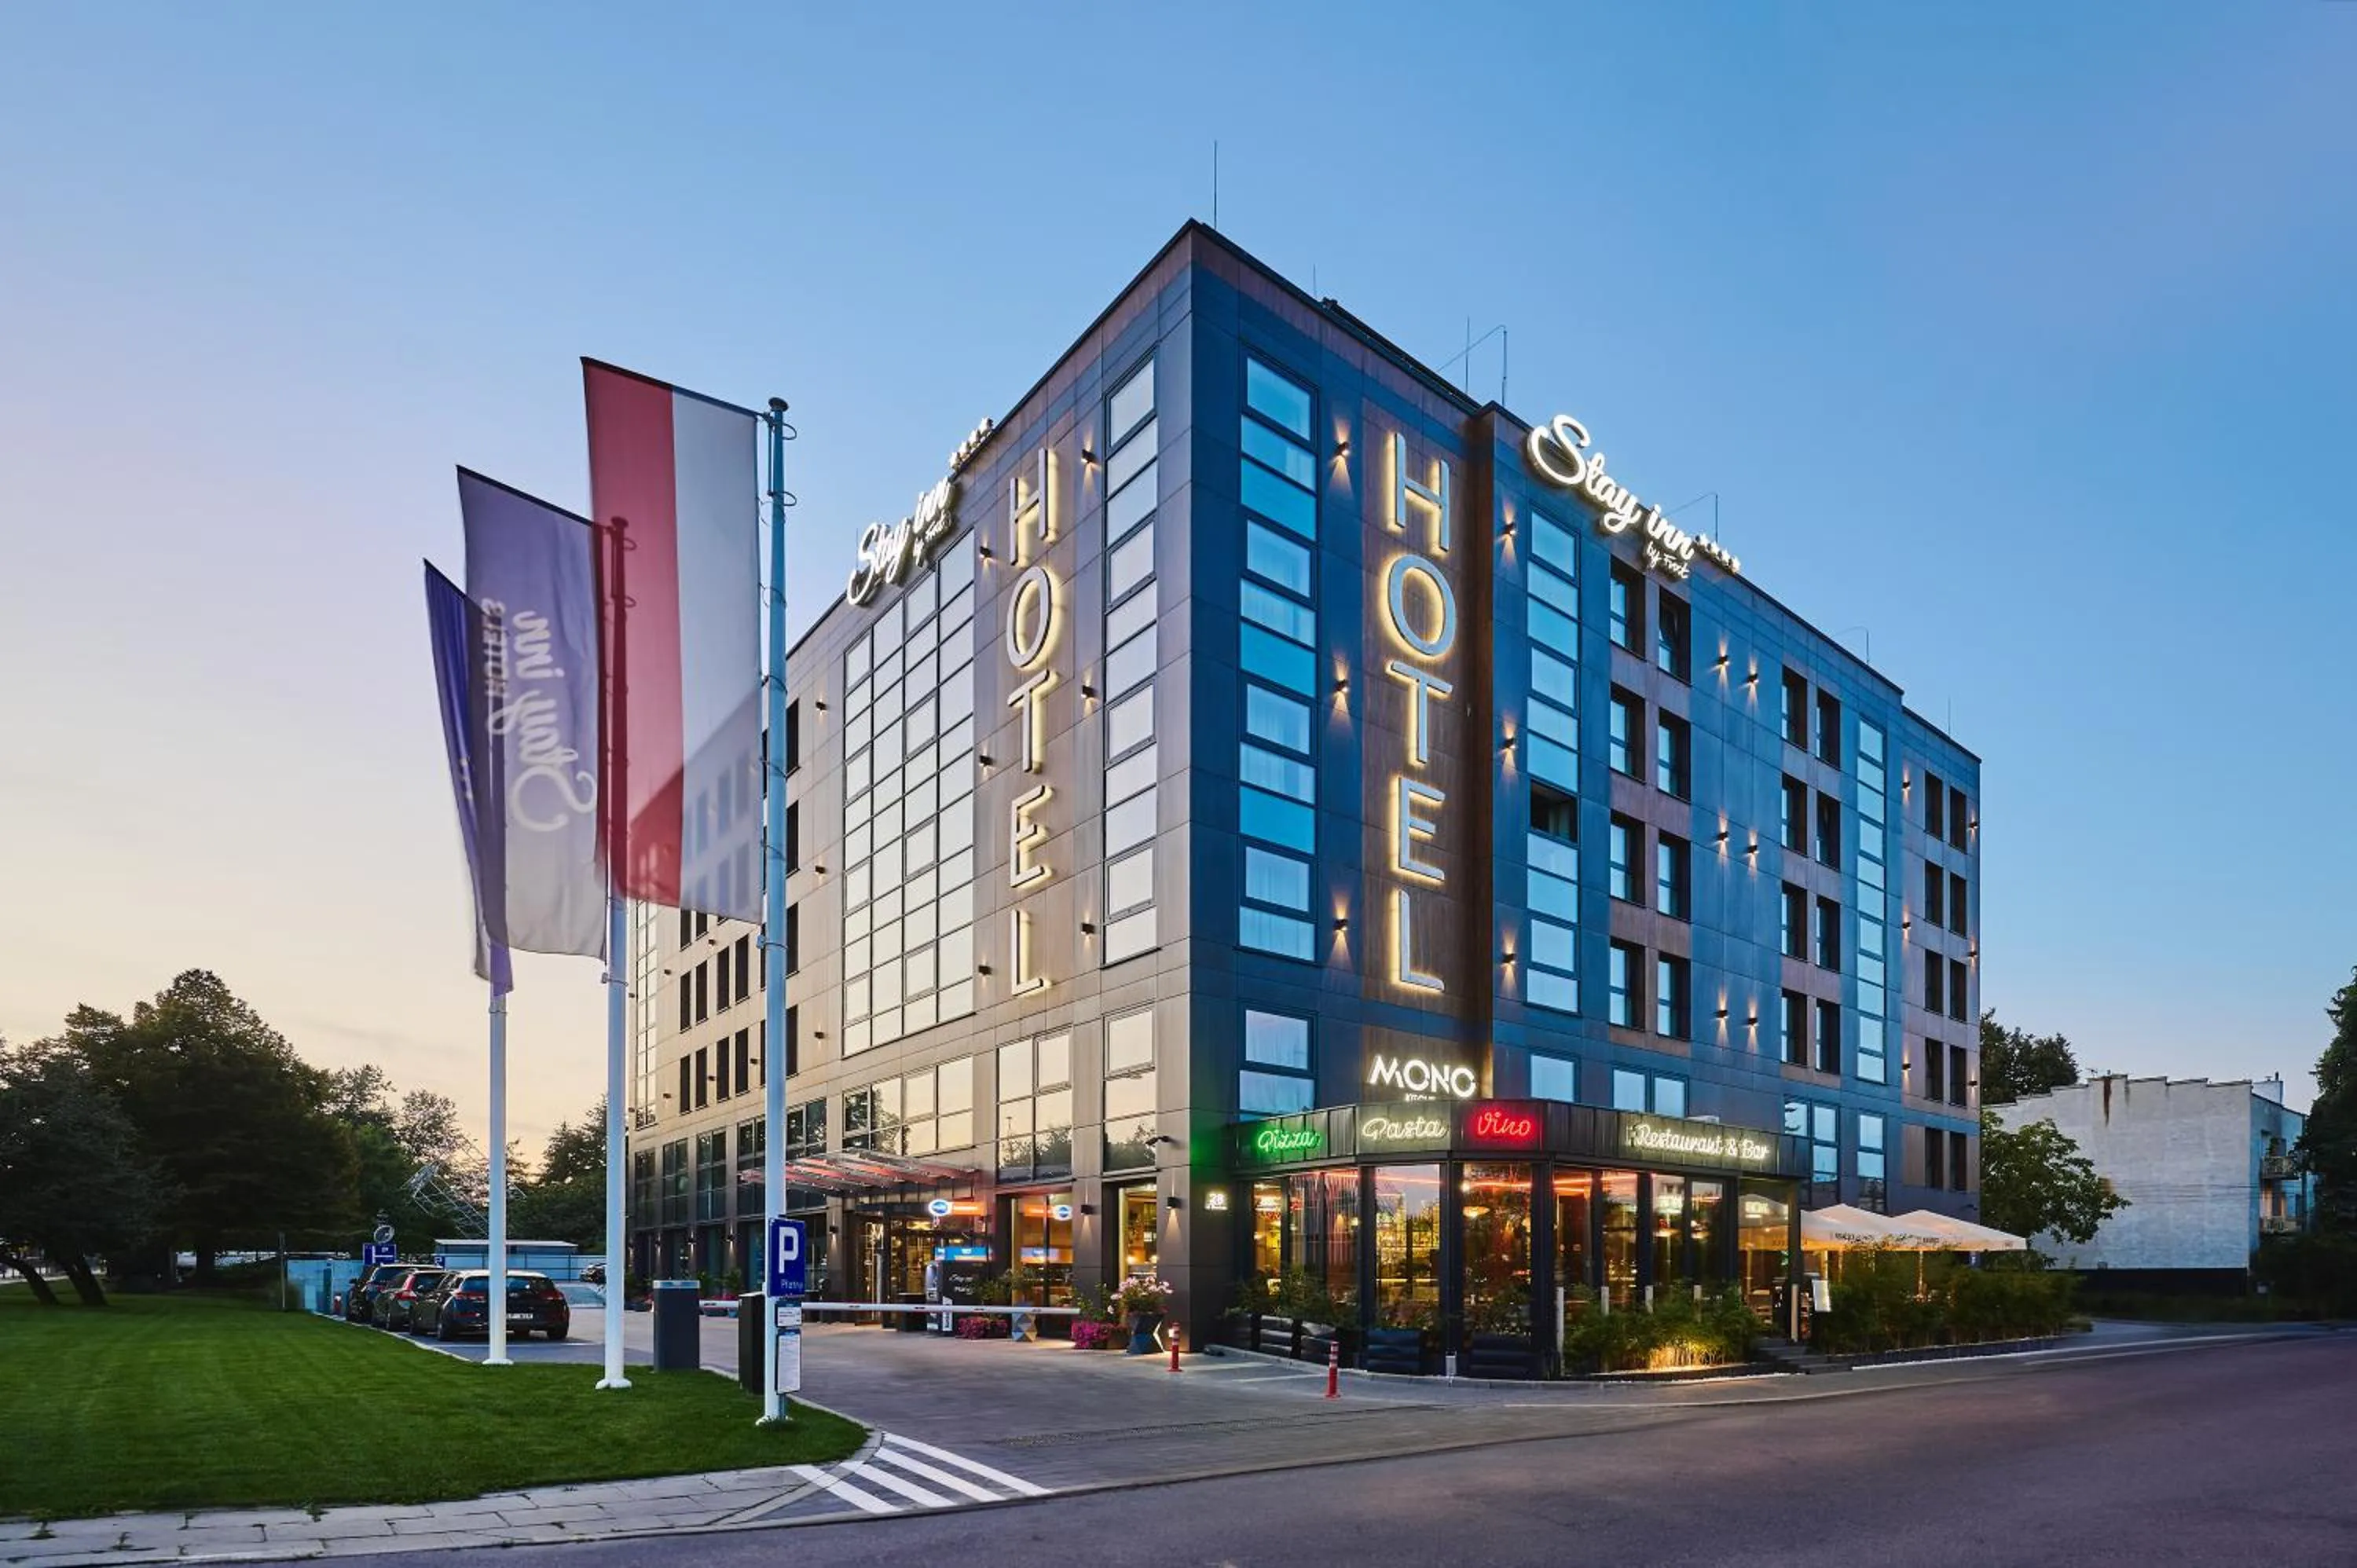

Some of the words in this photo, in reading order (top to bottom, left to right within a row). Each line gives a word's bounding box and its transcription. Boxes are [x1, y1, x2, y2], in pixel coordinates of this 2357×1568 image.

[1529, 414, 1642, 533] Stay
[1648, 504, 1695, 560] inn
[846, 518, 911, 605] Stay
[913, 476, 953, 534] inn
[1647, 540, 1662, 569] by
[1006, 447, 1053, 997] HOTEL
[1387, 431, 1456, 991] HOTEL
[1369, 1053, 1476, 1098] MONO
[1258, 1129, 1318, 1152] Pizza
[1362, 1115, 1449, 1140] Pasta
[1477, 1111, 1531, 1137] Vino
[1633, 1123, 1723, 1155] Restaurant
[1725, 1138, 1738, 1157] &
[1740, 1138, 1769, 1160] Bar
[779, 1226, 799, 1273] P
